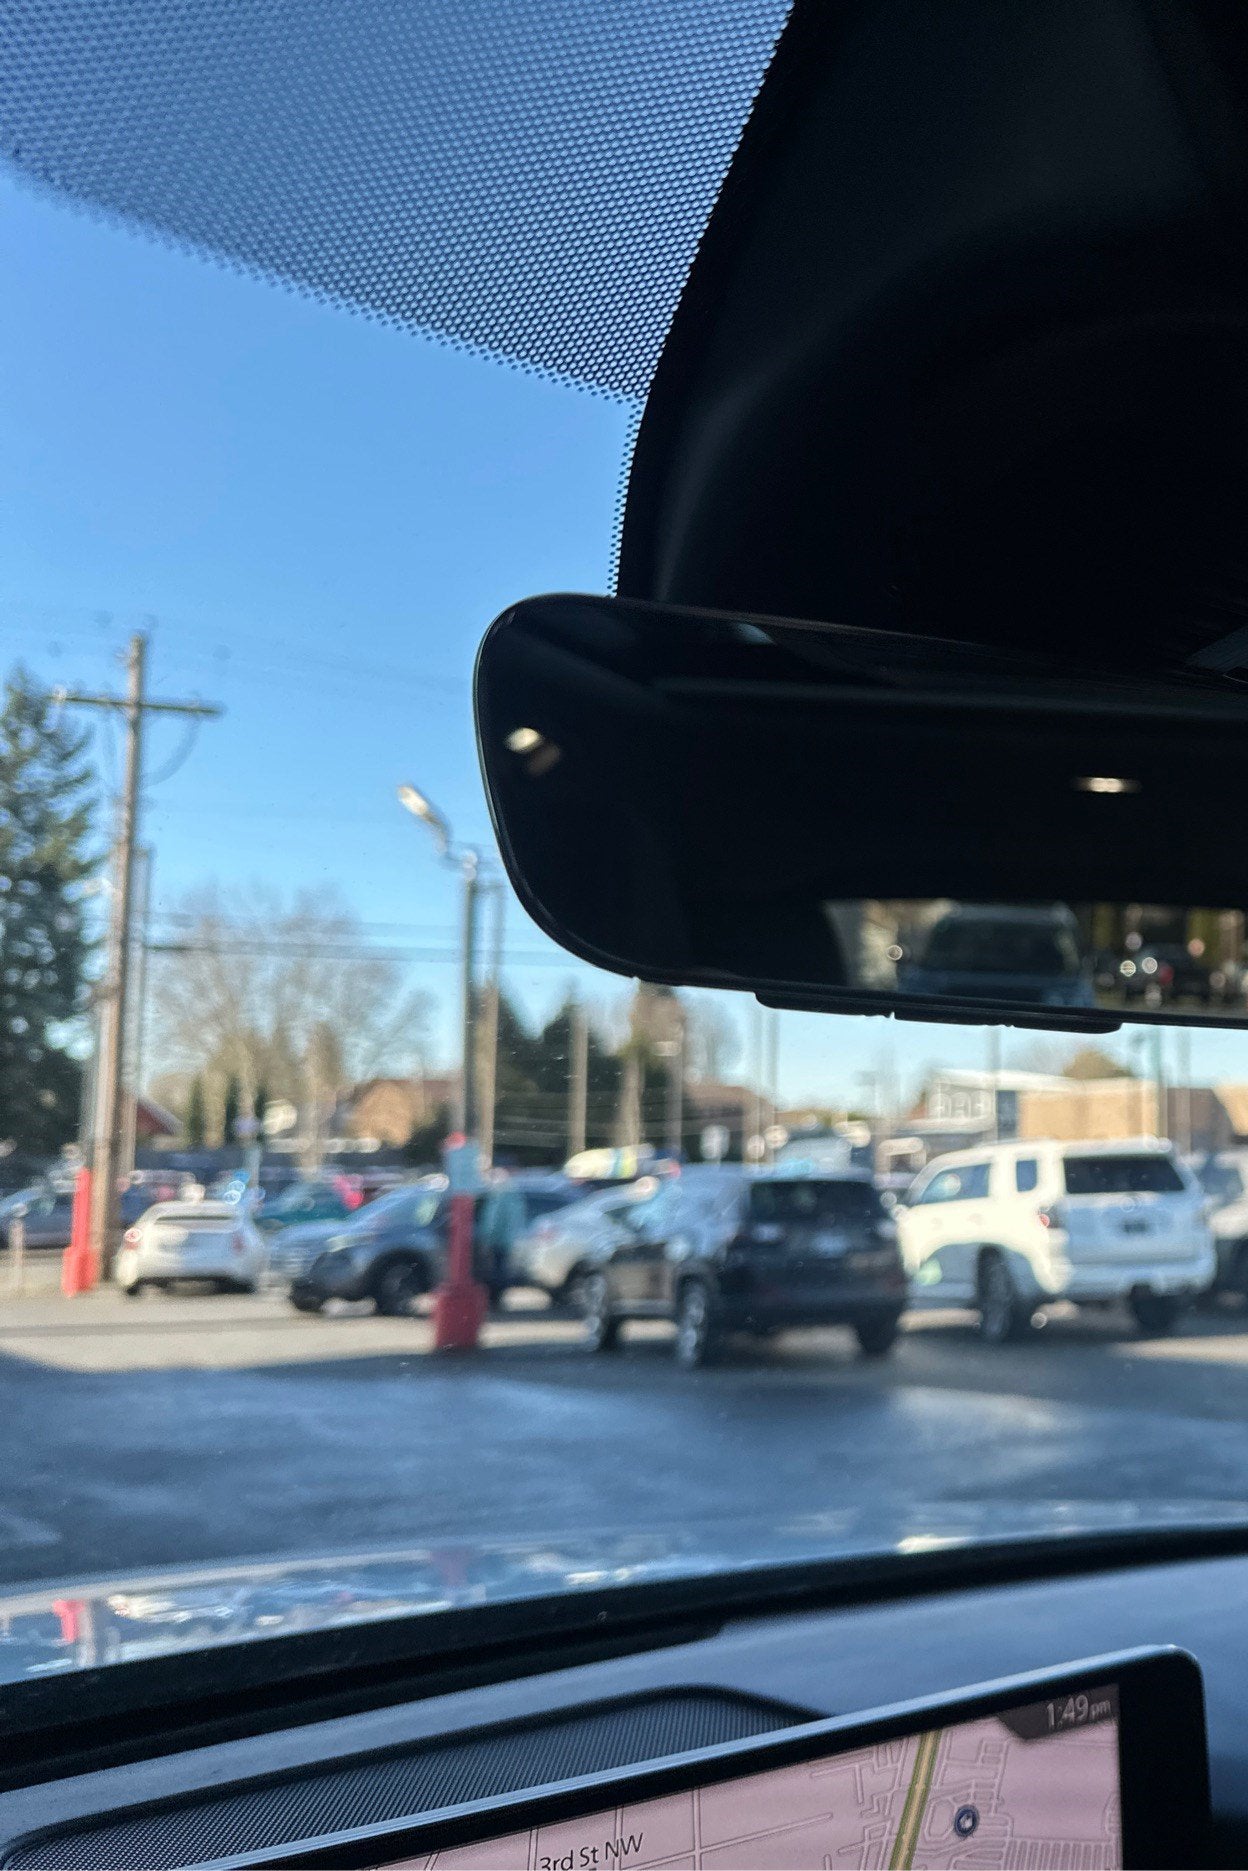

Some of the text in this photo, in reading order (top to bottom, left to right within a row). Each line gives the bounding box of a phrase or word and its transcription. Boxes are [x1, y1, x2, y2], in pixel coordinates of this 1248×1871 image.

[540, 1832, 643, 1870] 3rd St NW
